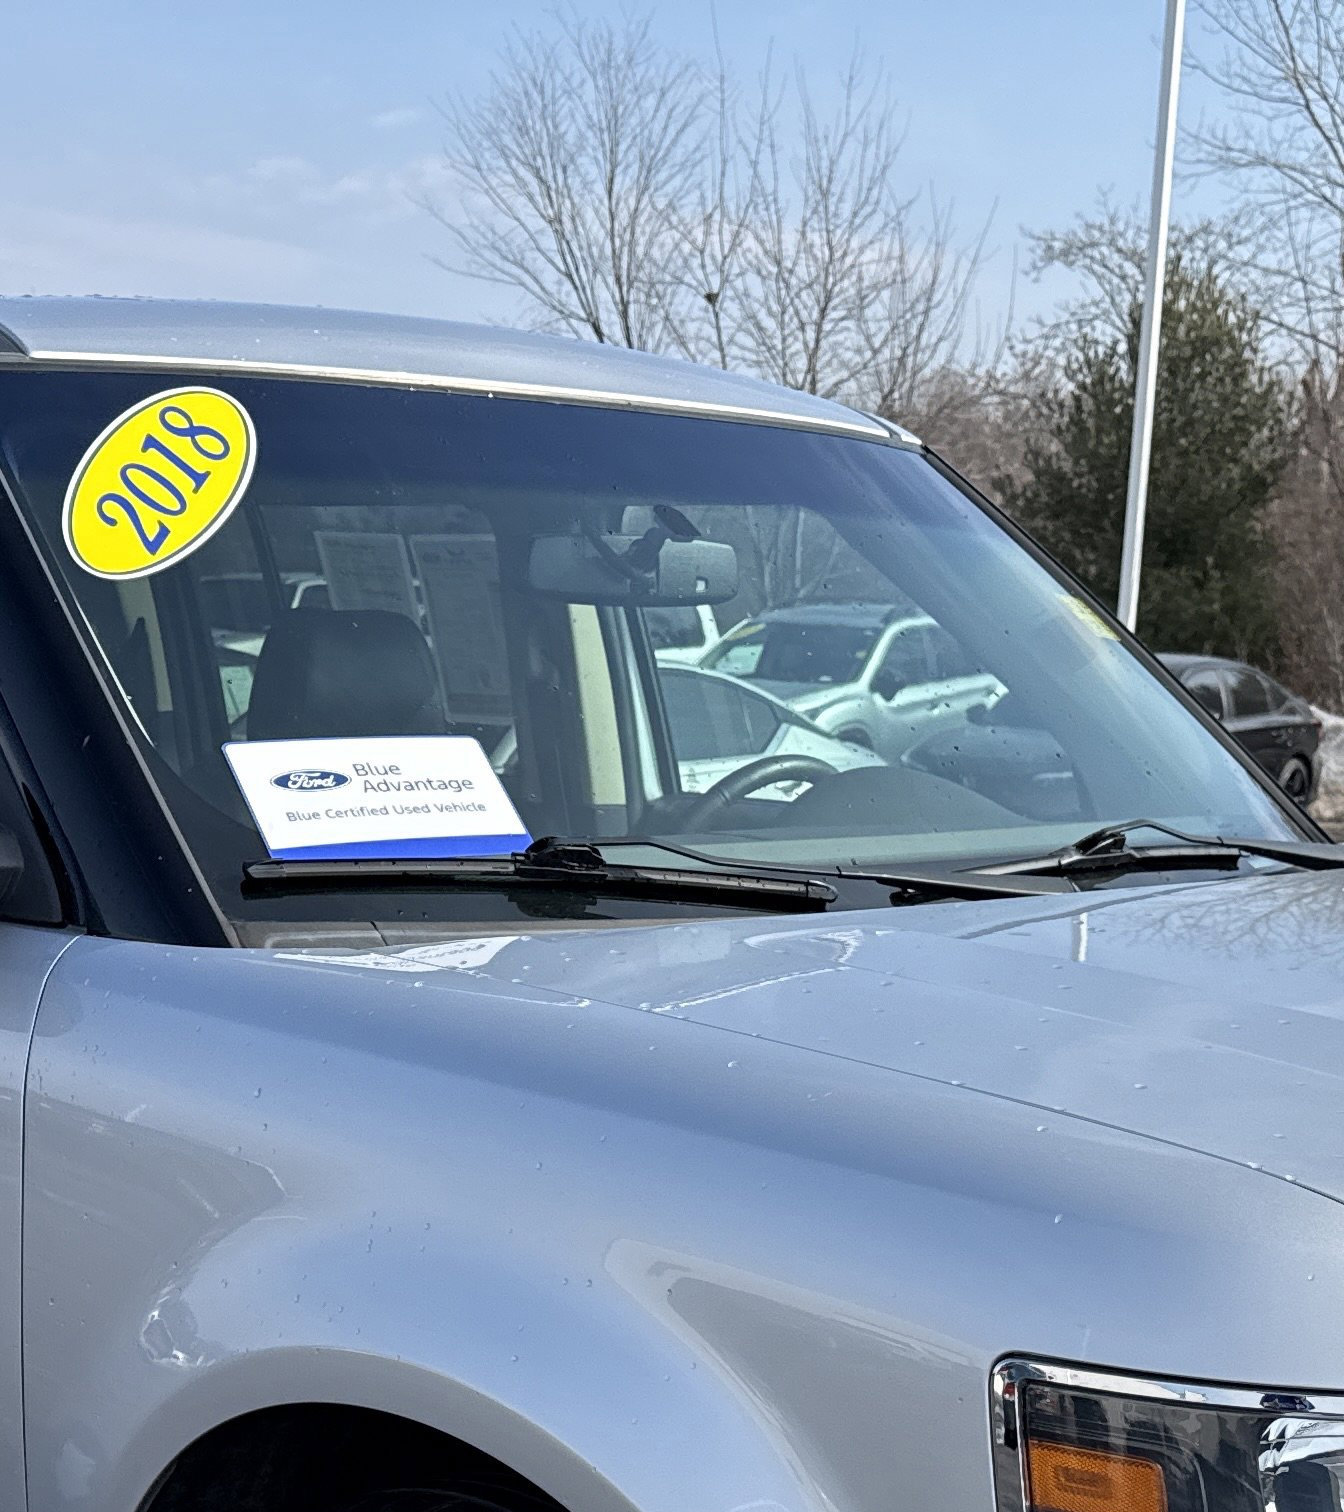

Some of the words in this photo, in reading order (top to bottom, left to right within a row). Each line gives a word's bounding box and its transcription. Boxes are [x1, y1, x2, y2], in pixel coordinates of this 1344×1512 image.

[96, 406, 231, 556] 2018
[352, 762, 402, 777] Blue
[287, 772, 337, 789] Ford
[363, 778, 475, 793] Advantage
[285, 810, 321, 822] Blue
[325, 805, 389, 819] Certified
[392, 803, 431, 815] Used
[433, 802, 487, 813] Vehicle
